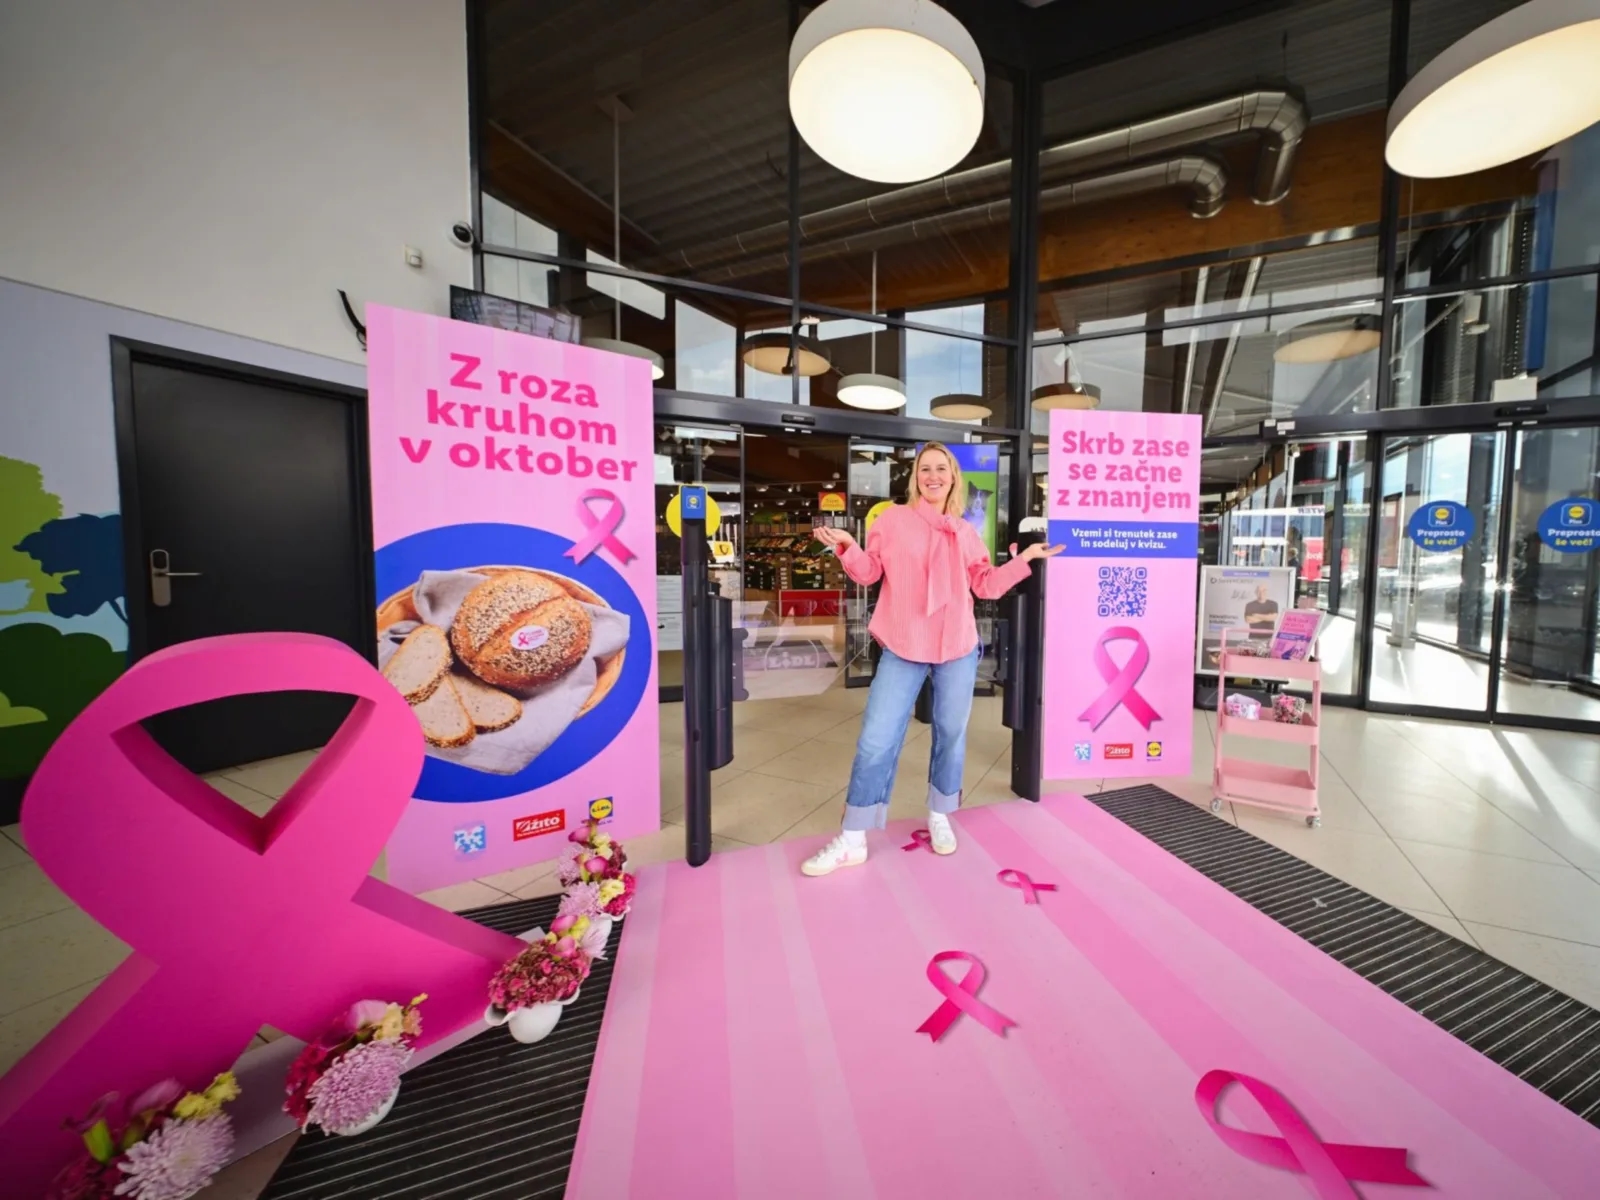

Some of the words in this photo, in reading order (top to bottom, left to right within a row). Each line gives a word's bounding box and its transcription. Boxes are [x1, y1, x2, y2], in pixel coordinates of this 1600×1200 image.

[450, 352, 482, 390] Z
[498, 369, 599, 408] roza
[426, 389, 617, 445] kruhom
[1062, 430, 1125, 455] Skrb
[1132, 438, 1190, 457] zase
[399, 437, 432, 463] v
[449, 436, 638, 481] oktober
[1068, 463, 1097, 480] se
[1105, 459, 1182, 483] začne
[1057, 489, 1070, 506] z
[1078, 484, 1191, 514] znanjem
[1072, 528, 1102, 538] Vzemi
[1103, 528, 1112, 538] si
[1114, 529, 1155, 539] trenutek
[1157, 531, 1178, 539] zase
[1081, 538, 1091, 548] in
[1092, 539, 1128, 550] sodeluj
[1138, 539, 1167, 549] kvizu.
[1417, 528, 1466, 538] Preprosto
